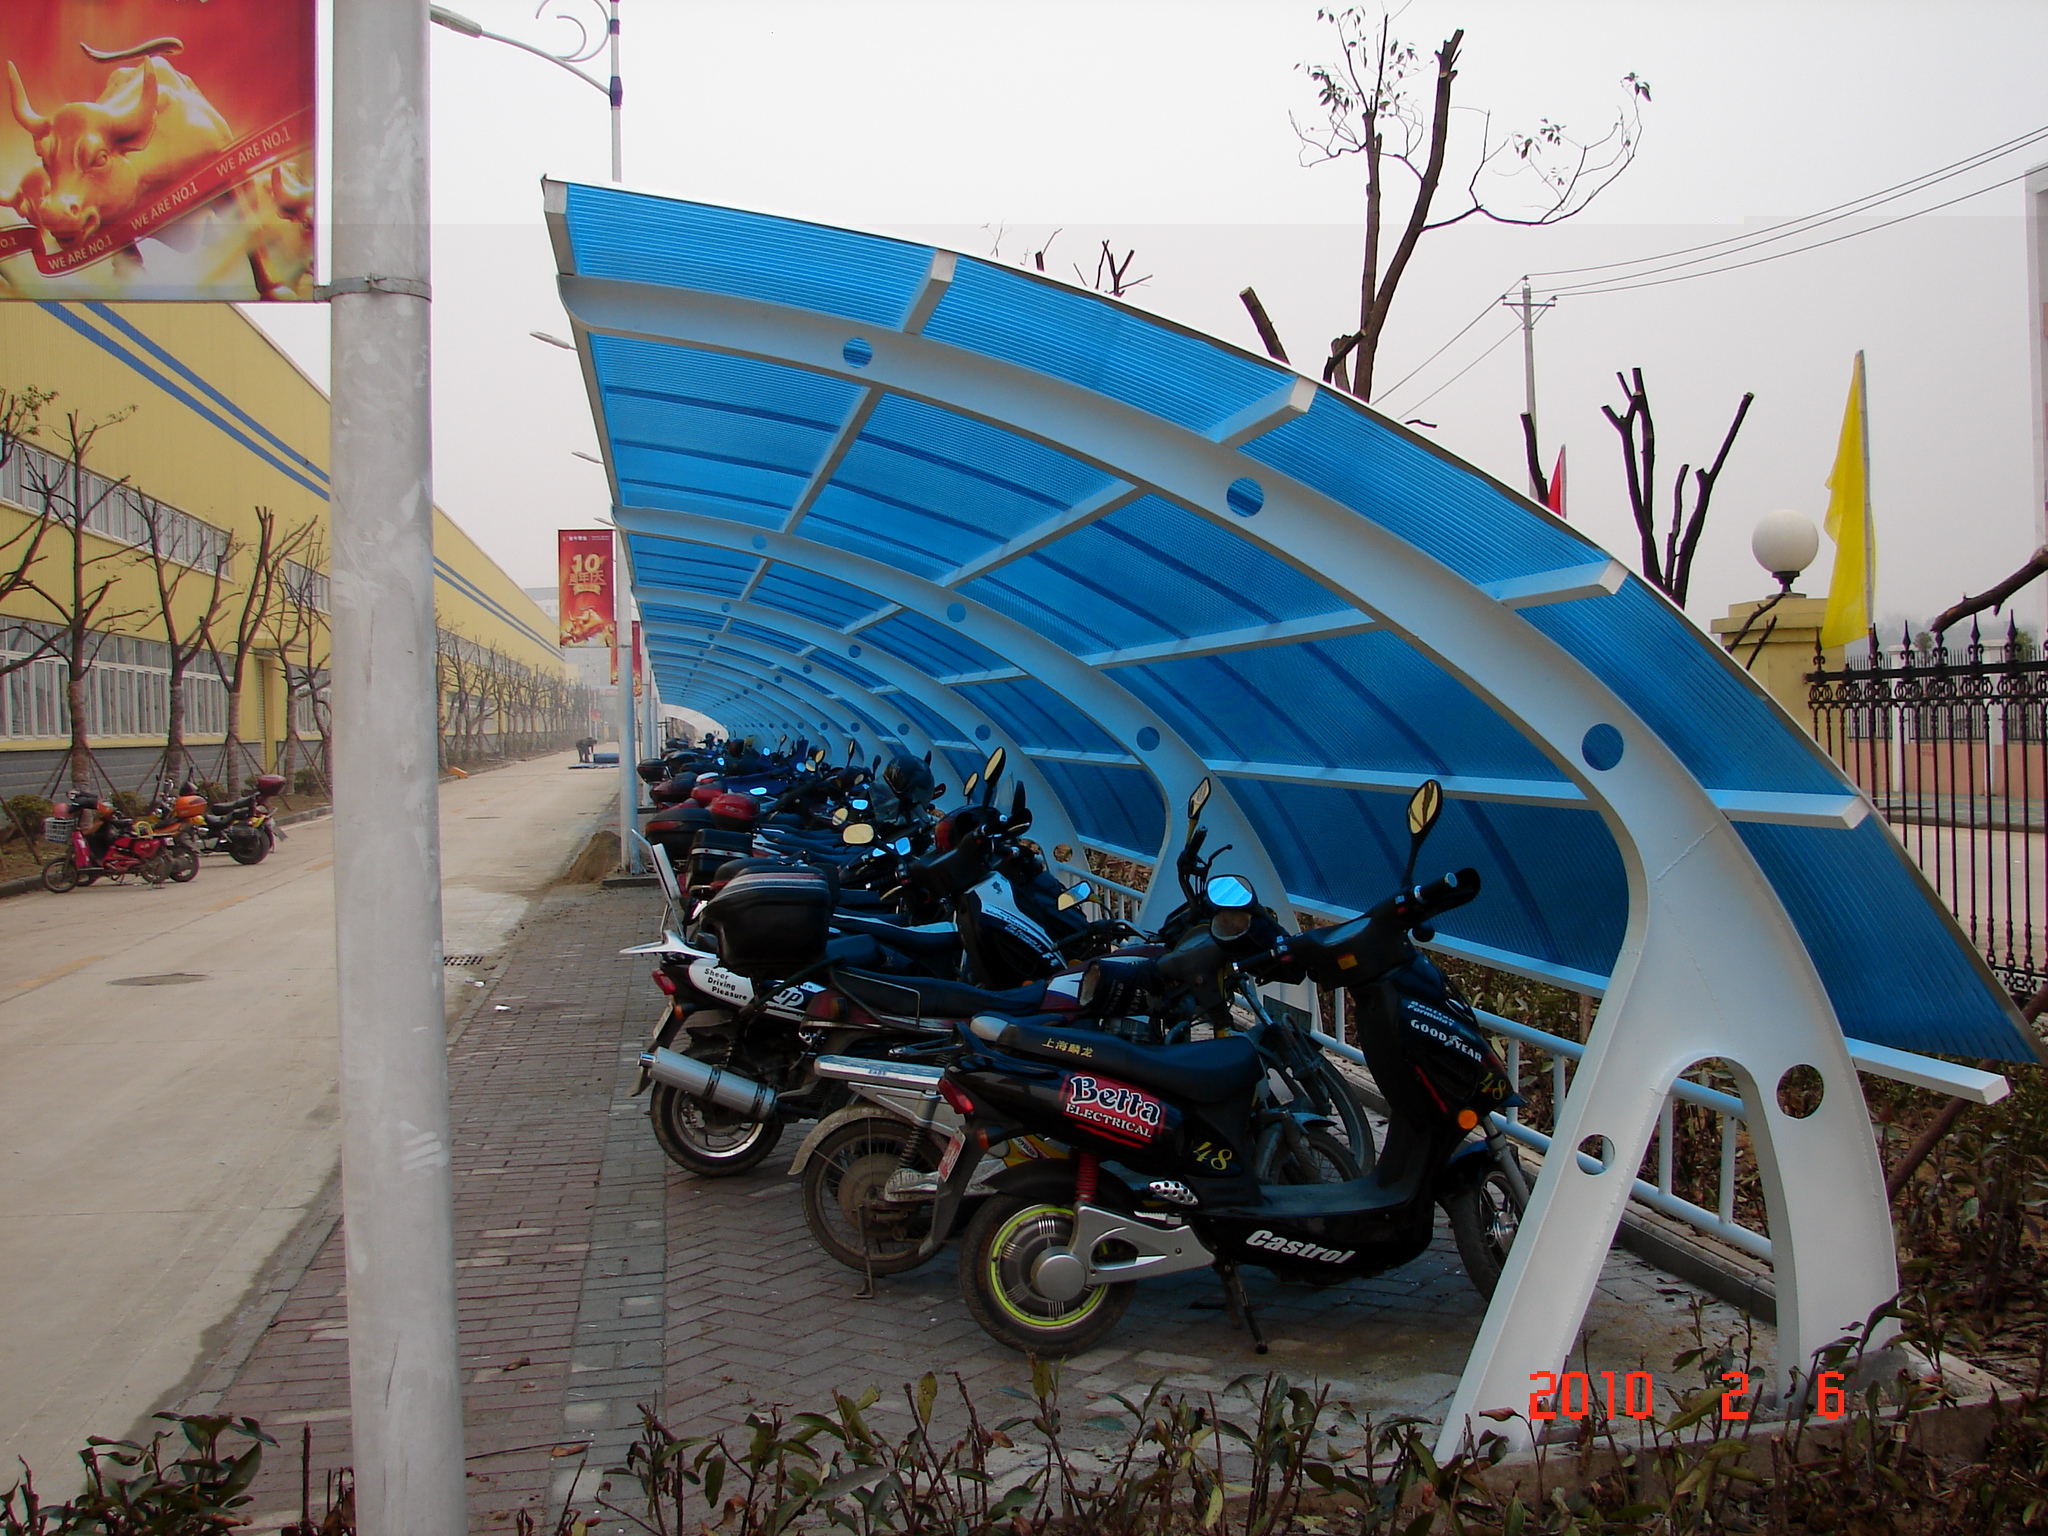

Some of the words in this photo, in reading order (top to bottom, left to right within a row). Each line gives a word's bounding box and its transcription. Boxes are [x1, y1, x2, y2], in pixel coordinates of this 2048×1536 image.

[216, 157, 236, 177] WE
[238, 143, 261, 166] ARE
[261, 126, 292, 153] NO.1
[131, 213, 149, 231] WE
[151, 200, 171, 220] ARE
[171, 181, 199, 207] NO.1
[0, 236, 17, 250] O.1
[48, 253, 67, 271] WE
[68, 245, 88, 264] ARE
[89, 234, 113, 256] NO.1
[704, 967, 729, 981] Sheer
[707, 977, 736, 992] Driving
[711, 986, 748, 1001] Pleasure
[1070, 1075, 1162, 1126] Betta
[1479, 1071, 1507, 1100] 48
[1065, 1102, 1152, 1138] ELECTRICAL
[1193, 1141, 1233, 1171] 48
[1245, 1229, 1356, 1264] Castrol
